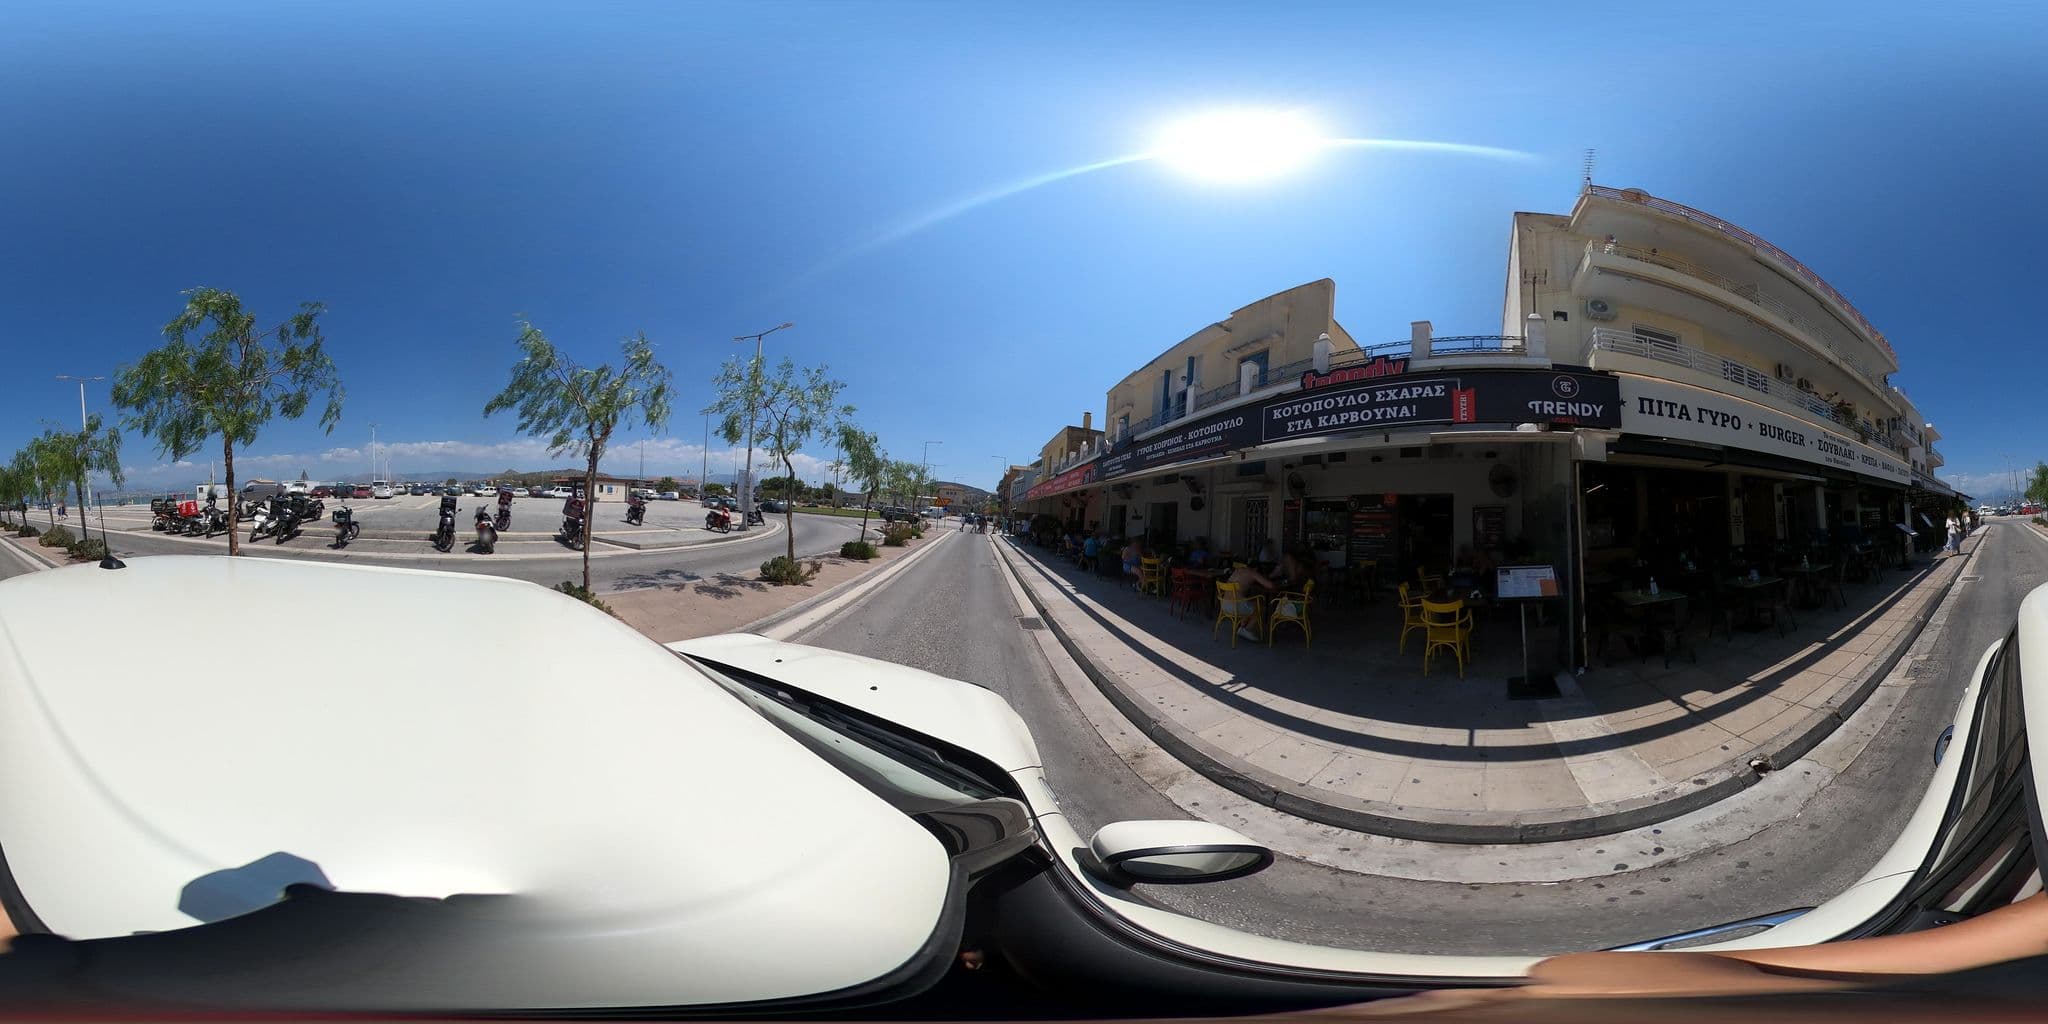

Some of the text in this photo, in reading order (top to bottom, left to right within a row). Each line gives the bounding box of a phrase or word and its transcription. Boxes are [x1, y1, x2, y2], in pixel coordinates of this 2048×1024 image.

[1273, 385, 1446, 420] ΚΟΤΟΠΟΥΛΟ ΣΧΑΡΑΣ
[1527, 400, 1604, 418] TRENDY
[1188, 416, 1244, 440] ΚΟΤΟΠΟΥΛΟ
[1287, 405, 1417, 433] ΣΤΑ ΚΑΡΒΟΥΝΑ!
[1638, 396, 1692, 421] ΠΙΤΑ
[1697, 407, 1741, 430] ΓΥΡΟ
[1759, 422, 1806, 447] BURGER
[1817, 439, 1855, 461] ΣΟΥΒΛΑΚΙ
